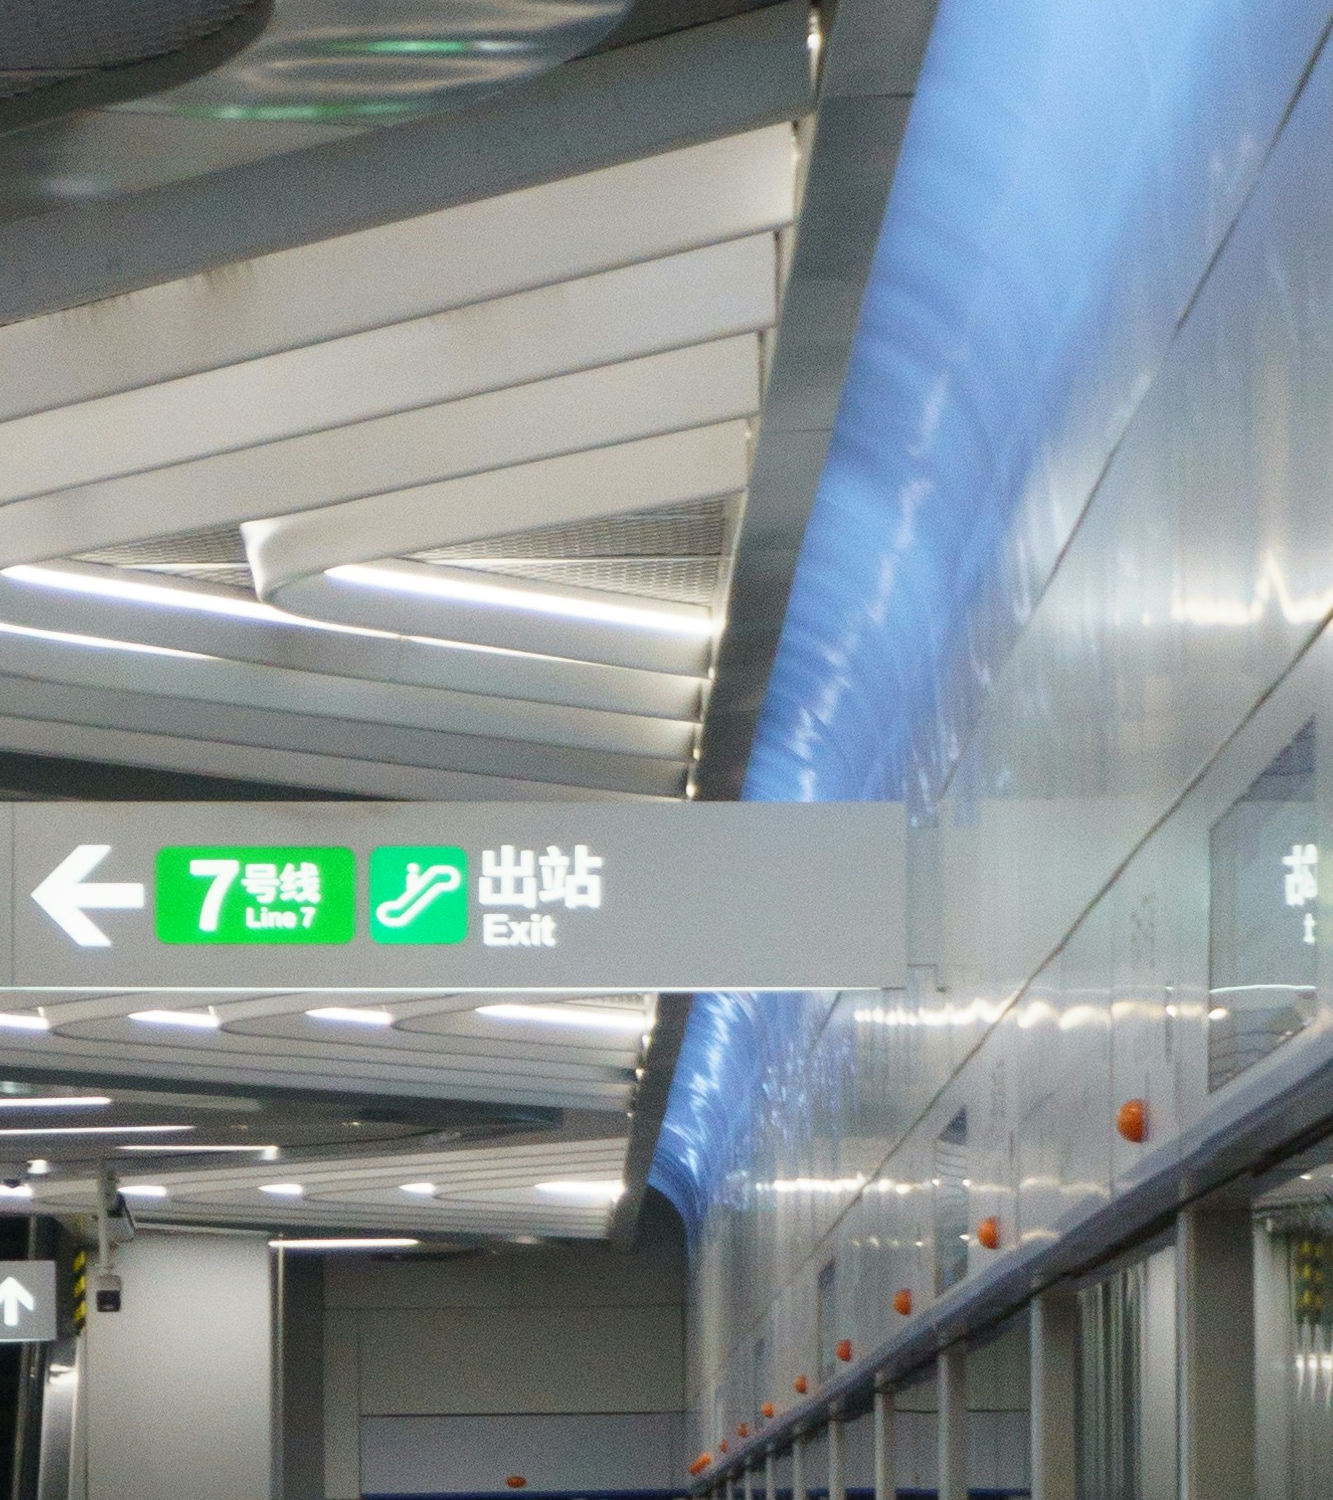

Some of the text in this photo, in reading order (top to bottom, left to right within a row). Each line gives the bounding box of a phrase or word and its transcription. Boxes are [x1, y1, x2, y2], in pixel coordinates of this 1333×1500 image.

[477, 843, 604, 910] 出站
[244, 905, 317, 929] Line 7
[482, 913, 558, 948] Exit
